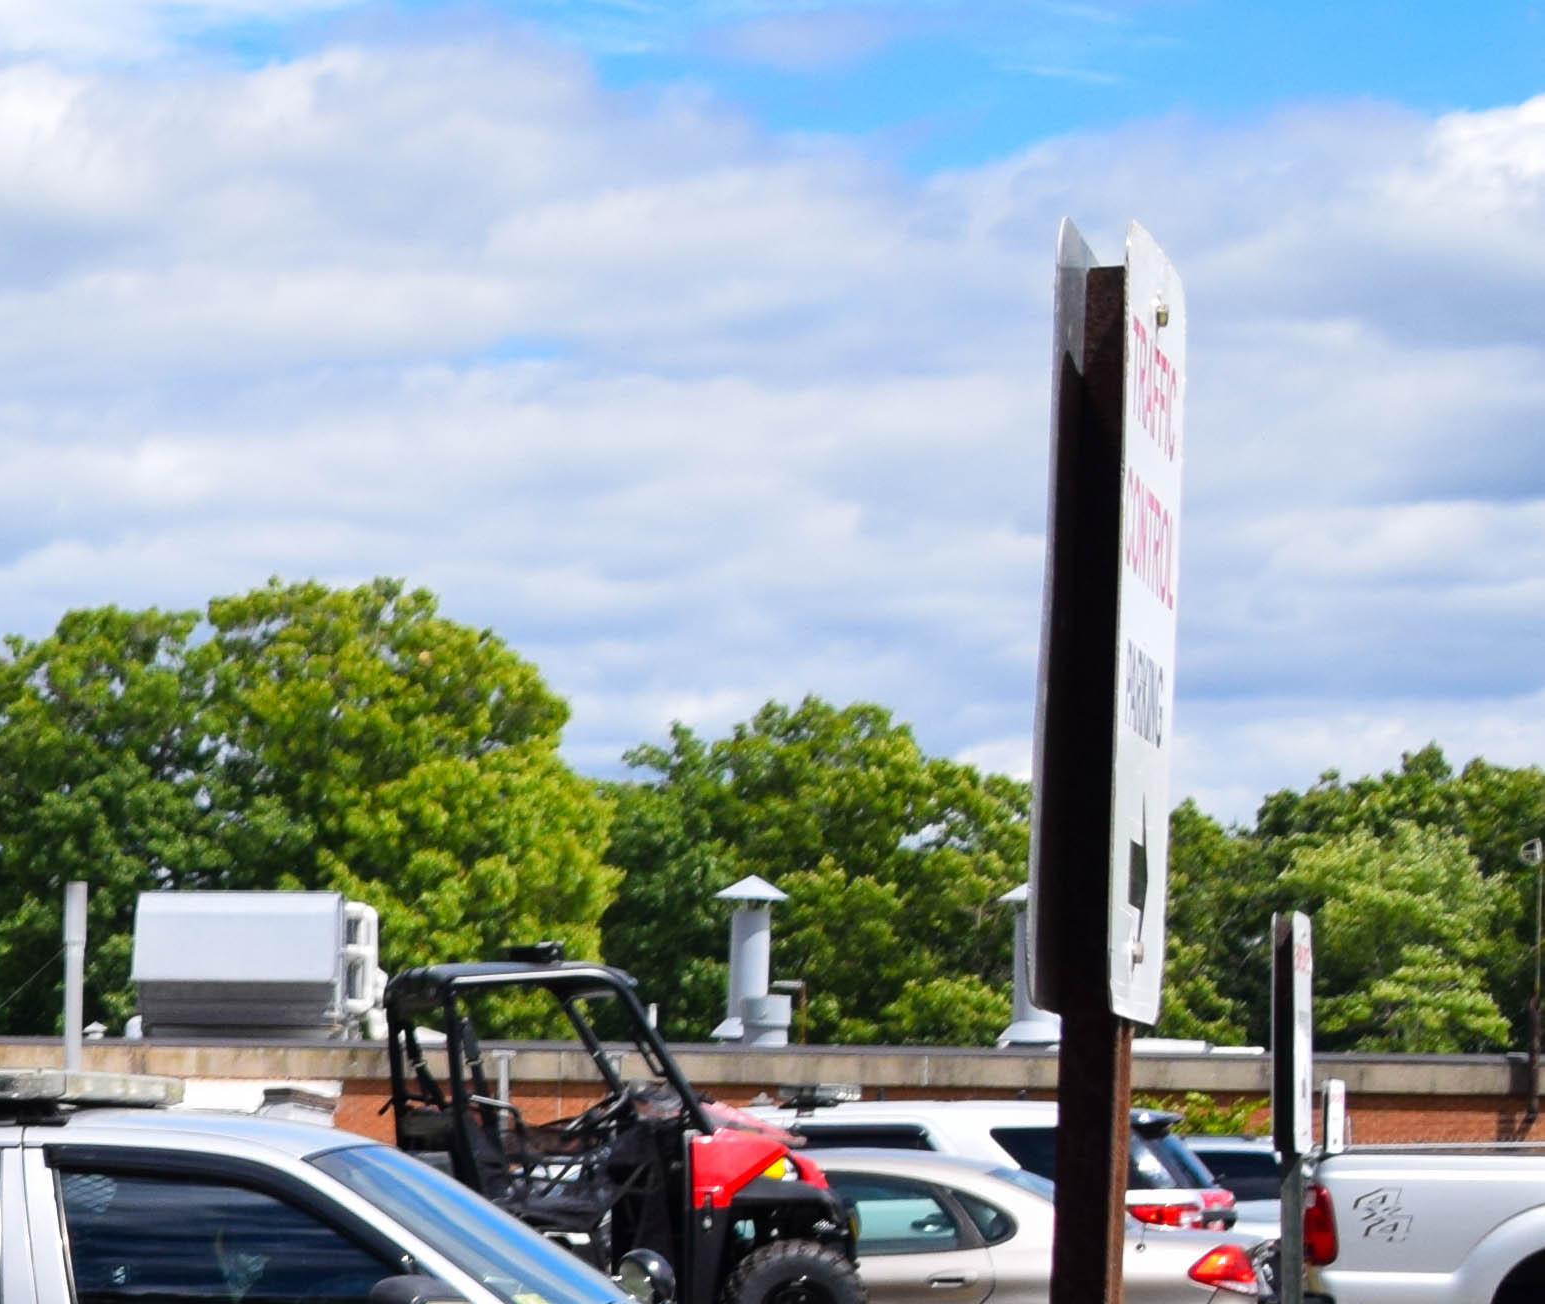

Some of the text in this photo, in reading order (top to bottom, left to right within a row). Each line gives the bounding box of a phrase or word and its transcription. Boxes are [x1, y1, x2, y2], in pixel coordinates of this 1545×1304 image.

[1133, 316, 1177, 462] TRAFFIC
[1125, 467, 1173, 611] CONTROL
[1124, 640, 1164, 749] PARKING
